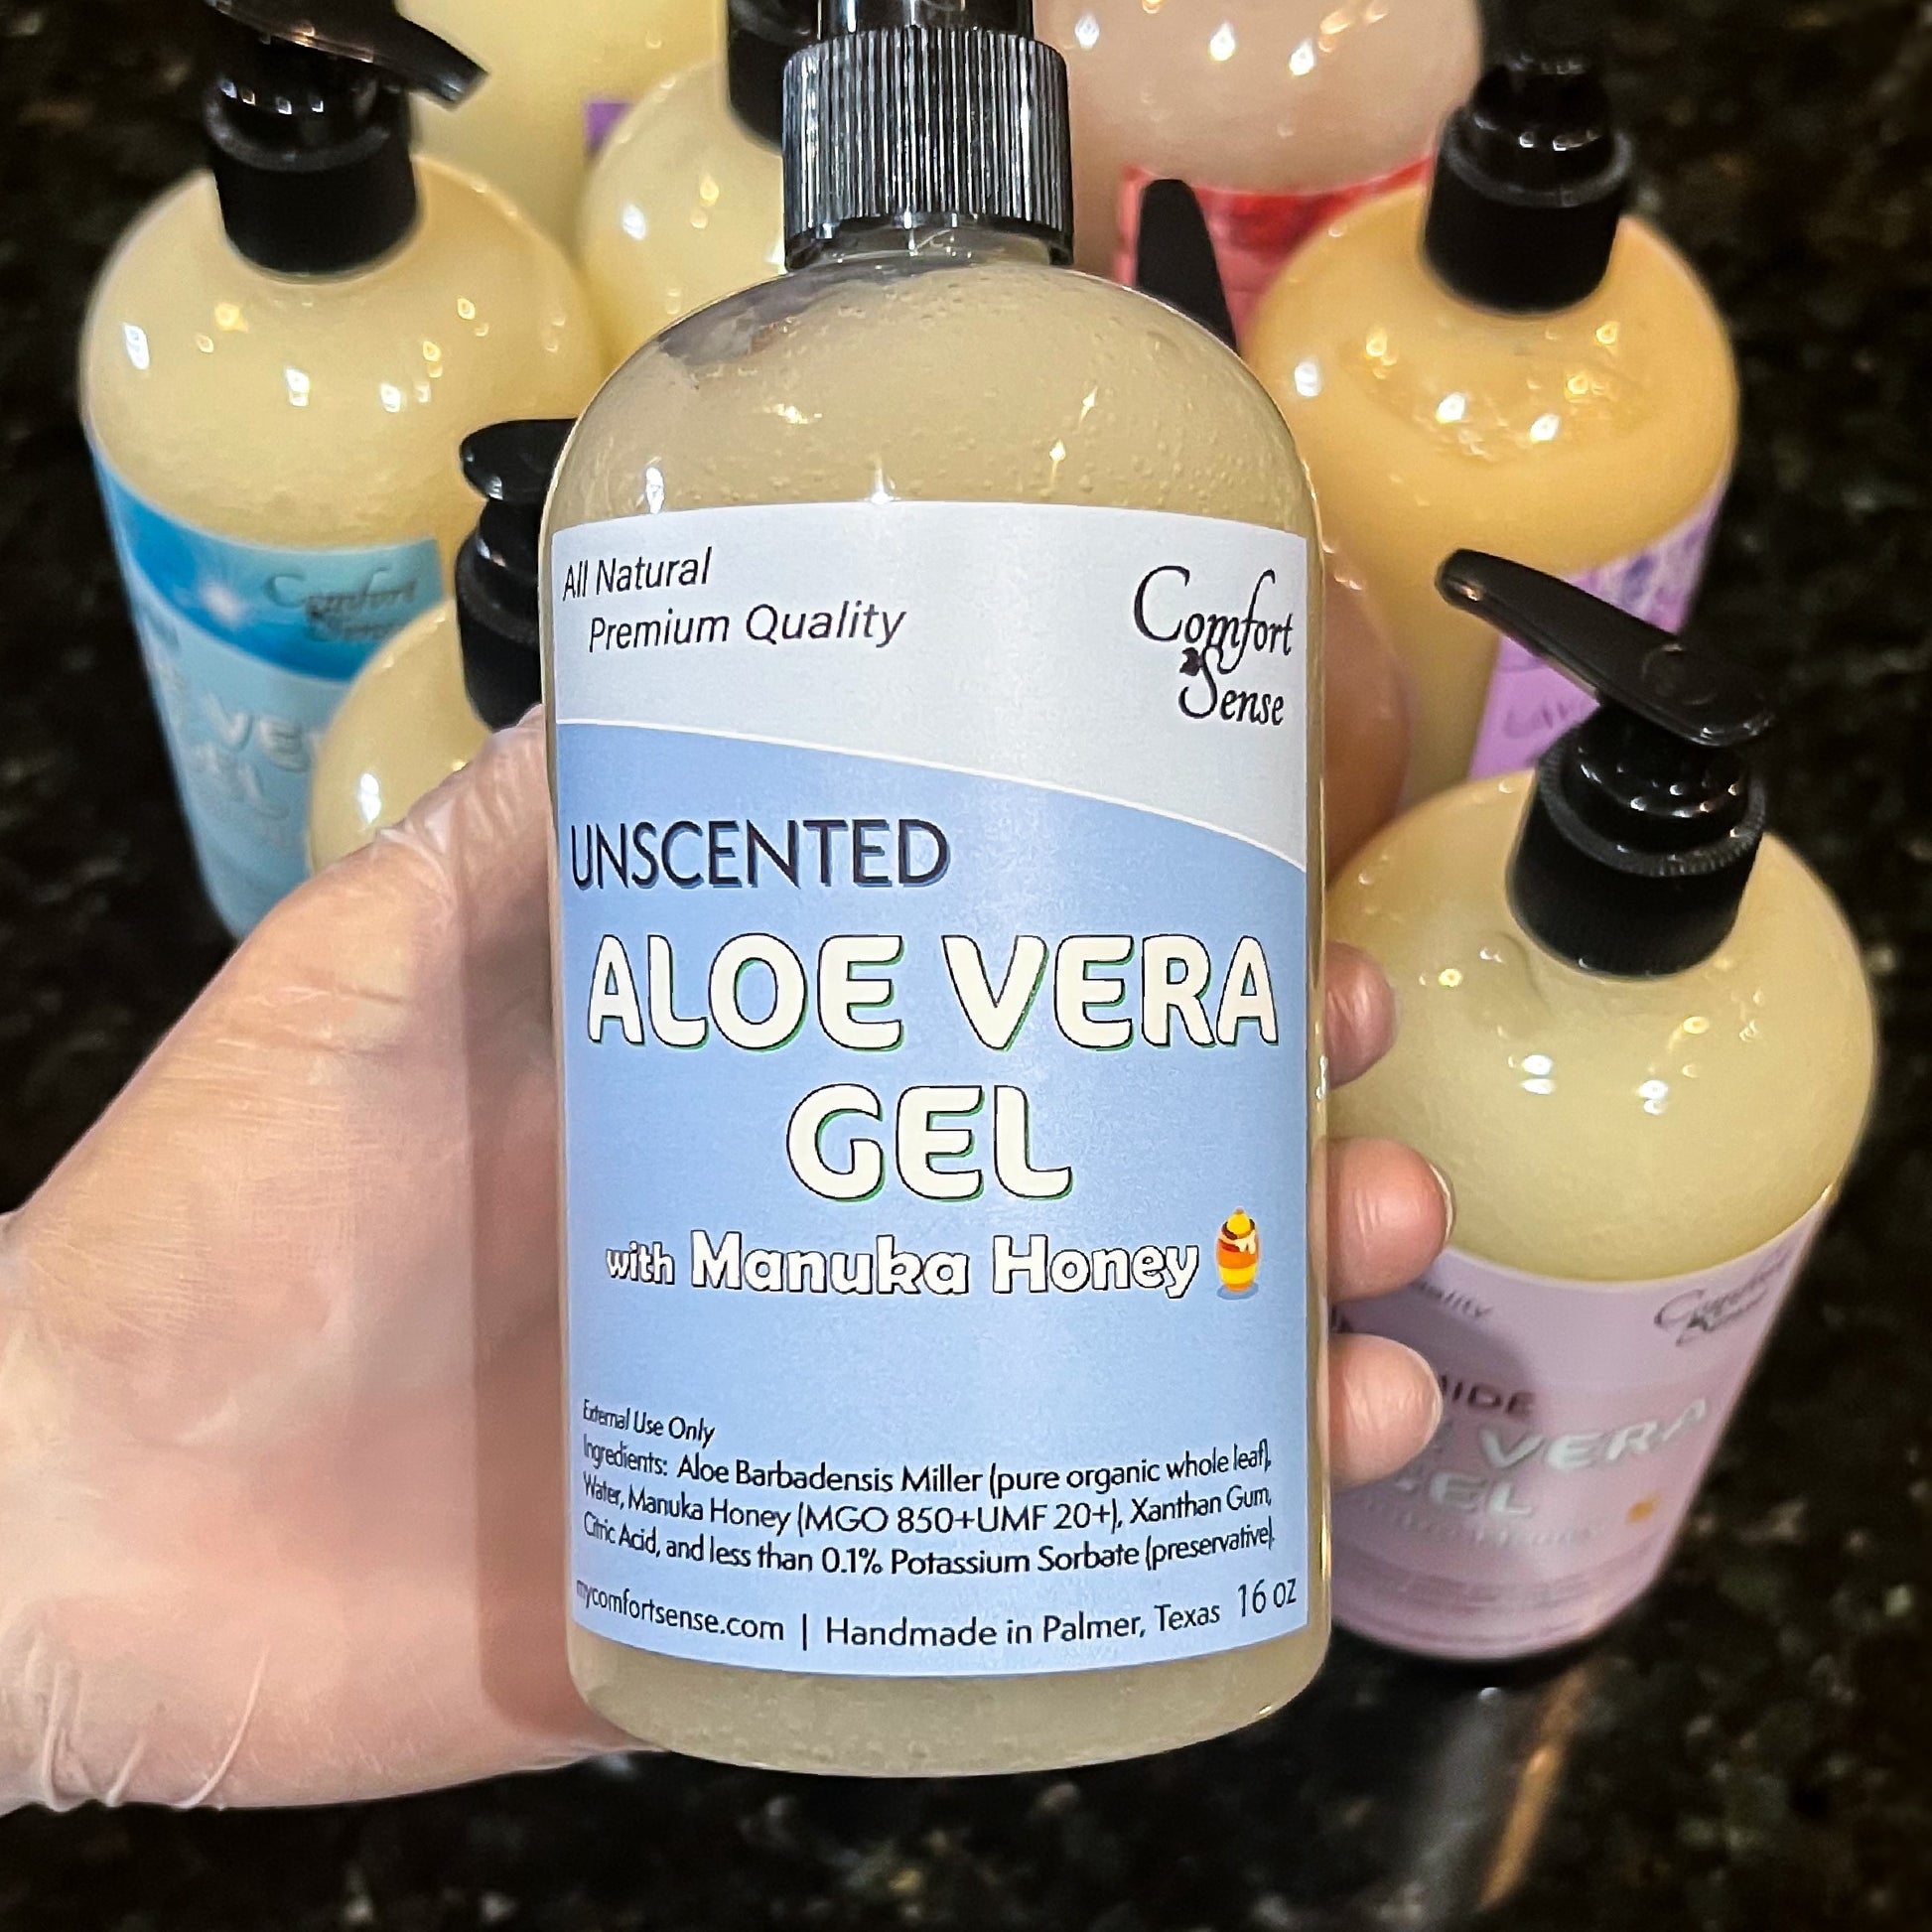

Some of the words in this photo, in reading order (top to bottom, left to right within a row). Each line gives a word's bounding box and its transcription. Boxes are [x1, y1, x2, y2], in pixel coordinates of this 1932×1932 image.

[563, 563, 589, 602] All
[595, 547, 713, 596] Natural
[589, 607, 730, 652] Premium
[745, 601, 906, 648] Quality
[1133, 566, 1294, 674] Comfort
[1178, 643, 1285, 726] Sense
[570, 819, 950, 890] UNSCENTED
[588, 933, 903, 1050] ALOE
[942, 934, 1279, 1050] VERA
[786, 1083, 1072, 1201] GEL
[606, 1241, 674, 1285] with
[690, 1230, 969, 1294] Manuka
[992, 1235, 1199, 1299] Honey
[583, 1398, 630, 1431] External
[633, 1410, 664, 1437] Use
[668, 1416, 716, 1449] Only
[1479, 1398, 1708, 1469] VERA
[583, 1433, 667, 1476] Ingredients:
[676, 1452, 730, 1483] Aloe
[736, 1459, 894, 1492] Barbadensis
[900, 1463, 983, 1492] Miller
[989, 1462, 1060, 1499] (pure
[1065, 1458, 1161, 1493] organic
[1166, 1447, 1230, 1480] whole
[583, 1470, 624, 1510] Water,
[627, 1483, 704, 1521] Manuka
[710, 1496, 791, 1536] Honey
[797, 1501, 890, 1538] (MGO
[897, 1504, 1047, 1534] 850+UMF
[1052, 1498, 1124, 1535] 20+),
[1129, 1489, 1222, 1524] Xanthan
[1226, 1484, 1273, 1512] Gum,
[583, 1510, 617, 1544] Citric
[618, 1523, 661, 1559] Acid,
[665, 1532, 705, 1563] and
[709, 1535, 753, 1569] less
[758, 1540, 814, 1573] than
[821, 1546, 884, 1576] 0.1%
[891, 1547, 1030, 1576] Potassium
[1037, 1540, 1141, 1573] Sorbate
[576, 1580, 784, 1641] mycomfortsense.com
[826, 1615, 998, 1647] Handmade
[1006, 1618, 1034, 1645] in
[1043, 1610, 1147, 1644] Palmer,
[1153, 1603, 1221, 1633] Texas
[1237, 1578, 1268, 1618] 16
[1273, 1578, 1298, 1609] oz
